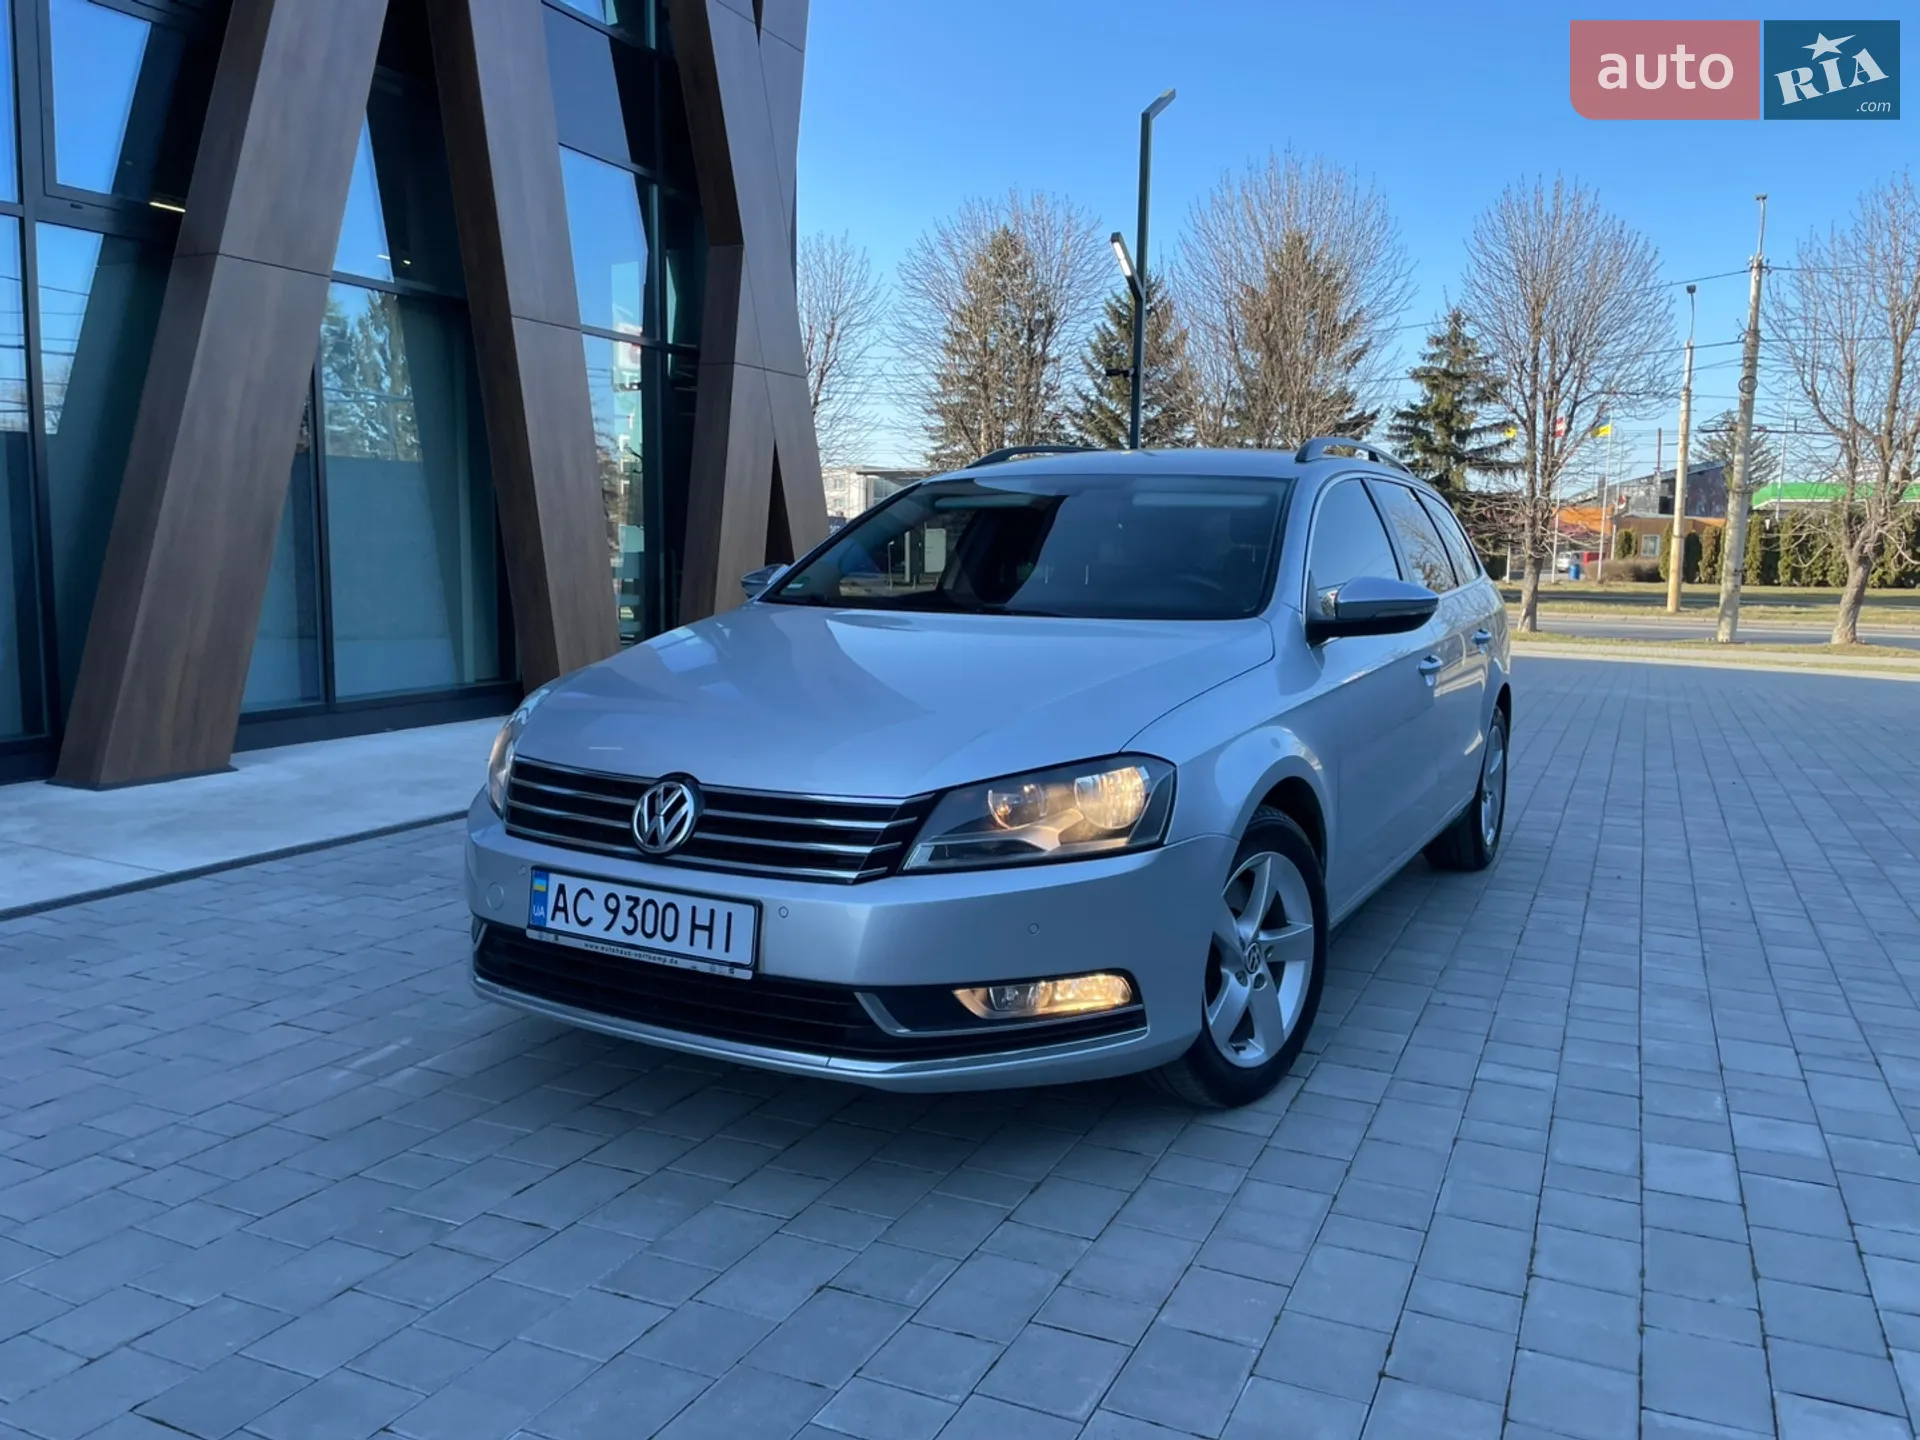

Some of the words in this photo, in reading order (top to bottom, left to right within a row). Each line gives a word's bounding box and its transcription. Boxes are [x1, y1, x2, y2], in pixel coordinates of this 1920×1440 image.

[532, 904, 546, 918] UA
[550, 882, 595, 928] AC
[603, 891, 680, 943] 9300
[688, 904, 733, 954] HI
